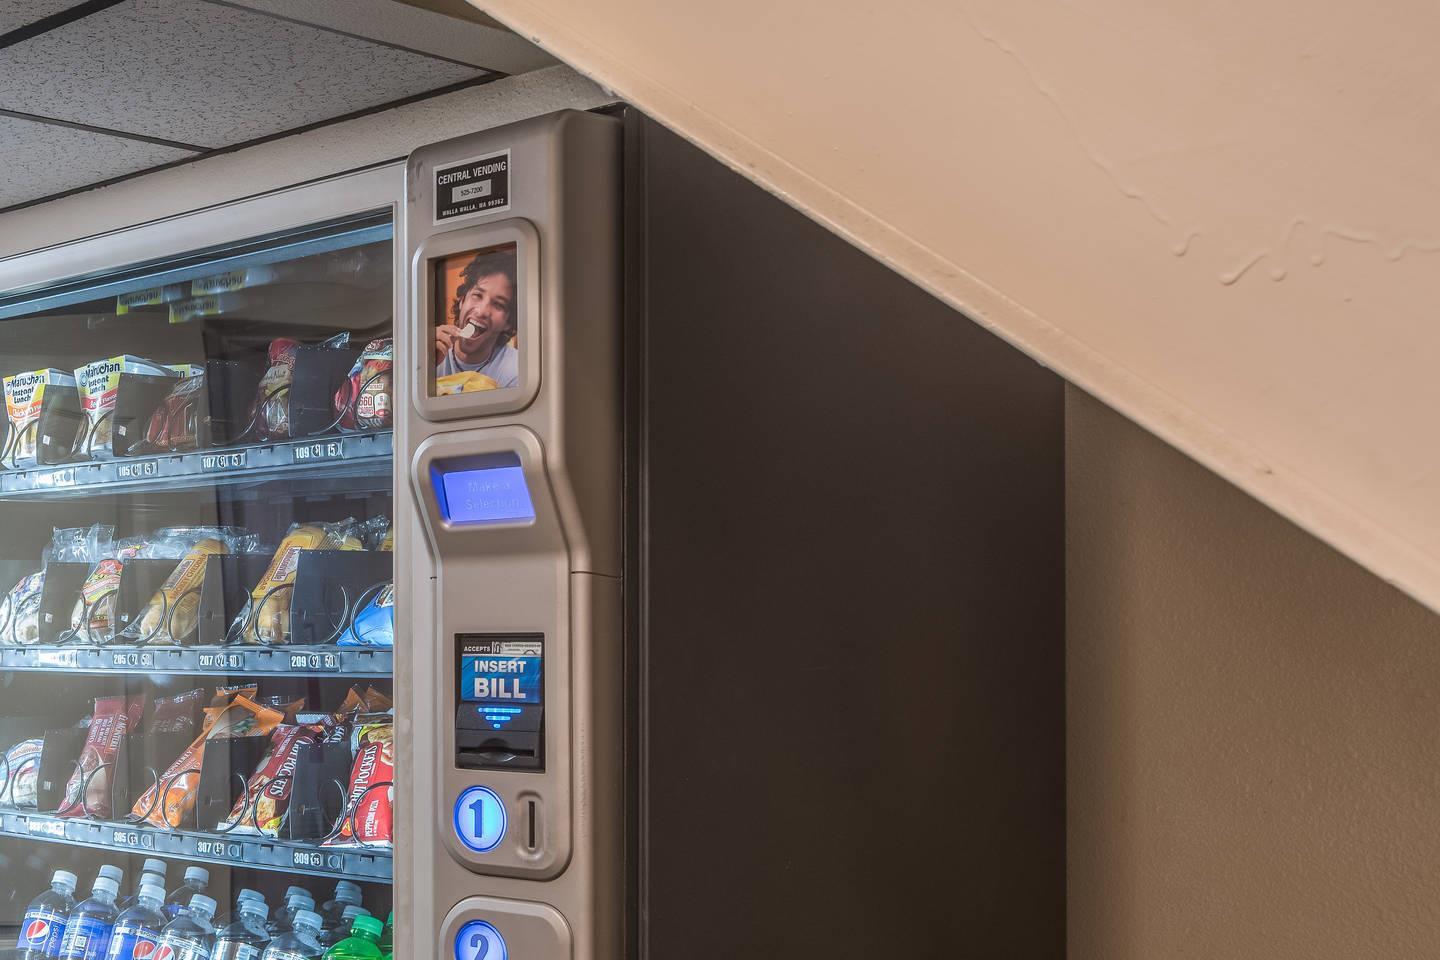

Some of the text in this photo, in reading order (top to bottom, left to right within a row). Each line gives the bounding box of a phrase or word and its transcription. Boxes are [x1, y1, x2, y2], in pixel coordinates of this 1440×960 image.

[438, 161, 506, 185] CENTRAL VENDING
[85, 362, 120, 378] Maruchan
[11, 374, 44, 388] Maruchan
[88, 376, 109, 388] Instant
[12, 386, 34, 397] Instant
[90, 386, 106, 394] Lunch
[14, 395, 32, 404] Lunch
[294, 447, 310, 460] 109
[202, 456, 216, 468] 107
[118, 465, 130, 476] 105
[113, 654, 126, 664] 205
[200, 656, 214, 666] 207
[291, 656, 307, 667] 209
[474, 660, 526, 672] INSERT
[474, 678, 526, 698] BILL
[356, 745, 378, 787] POCKETS
[468, 798, 483, 838] 1
[198, 842, 212, 853] 307
[294, 852, 309, 864] 309
[48, 925, 58, 949] pepsi
